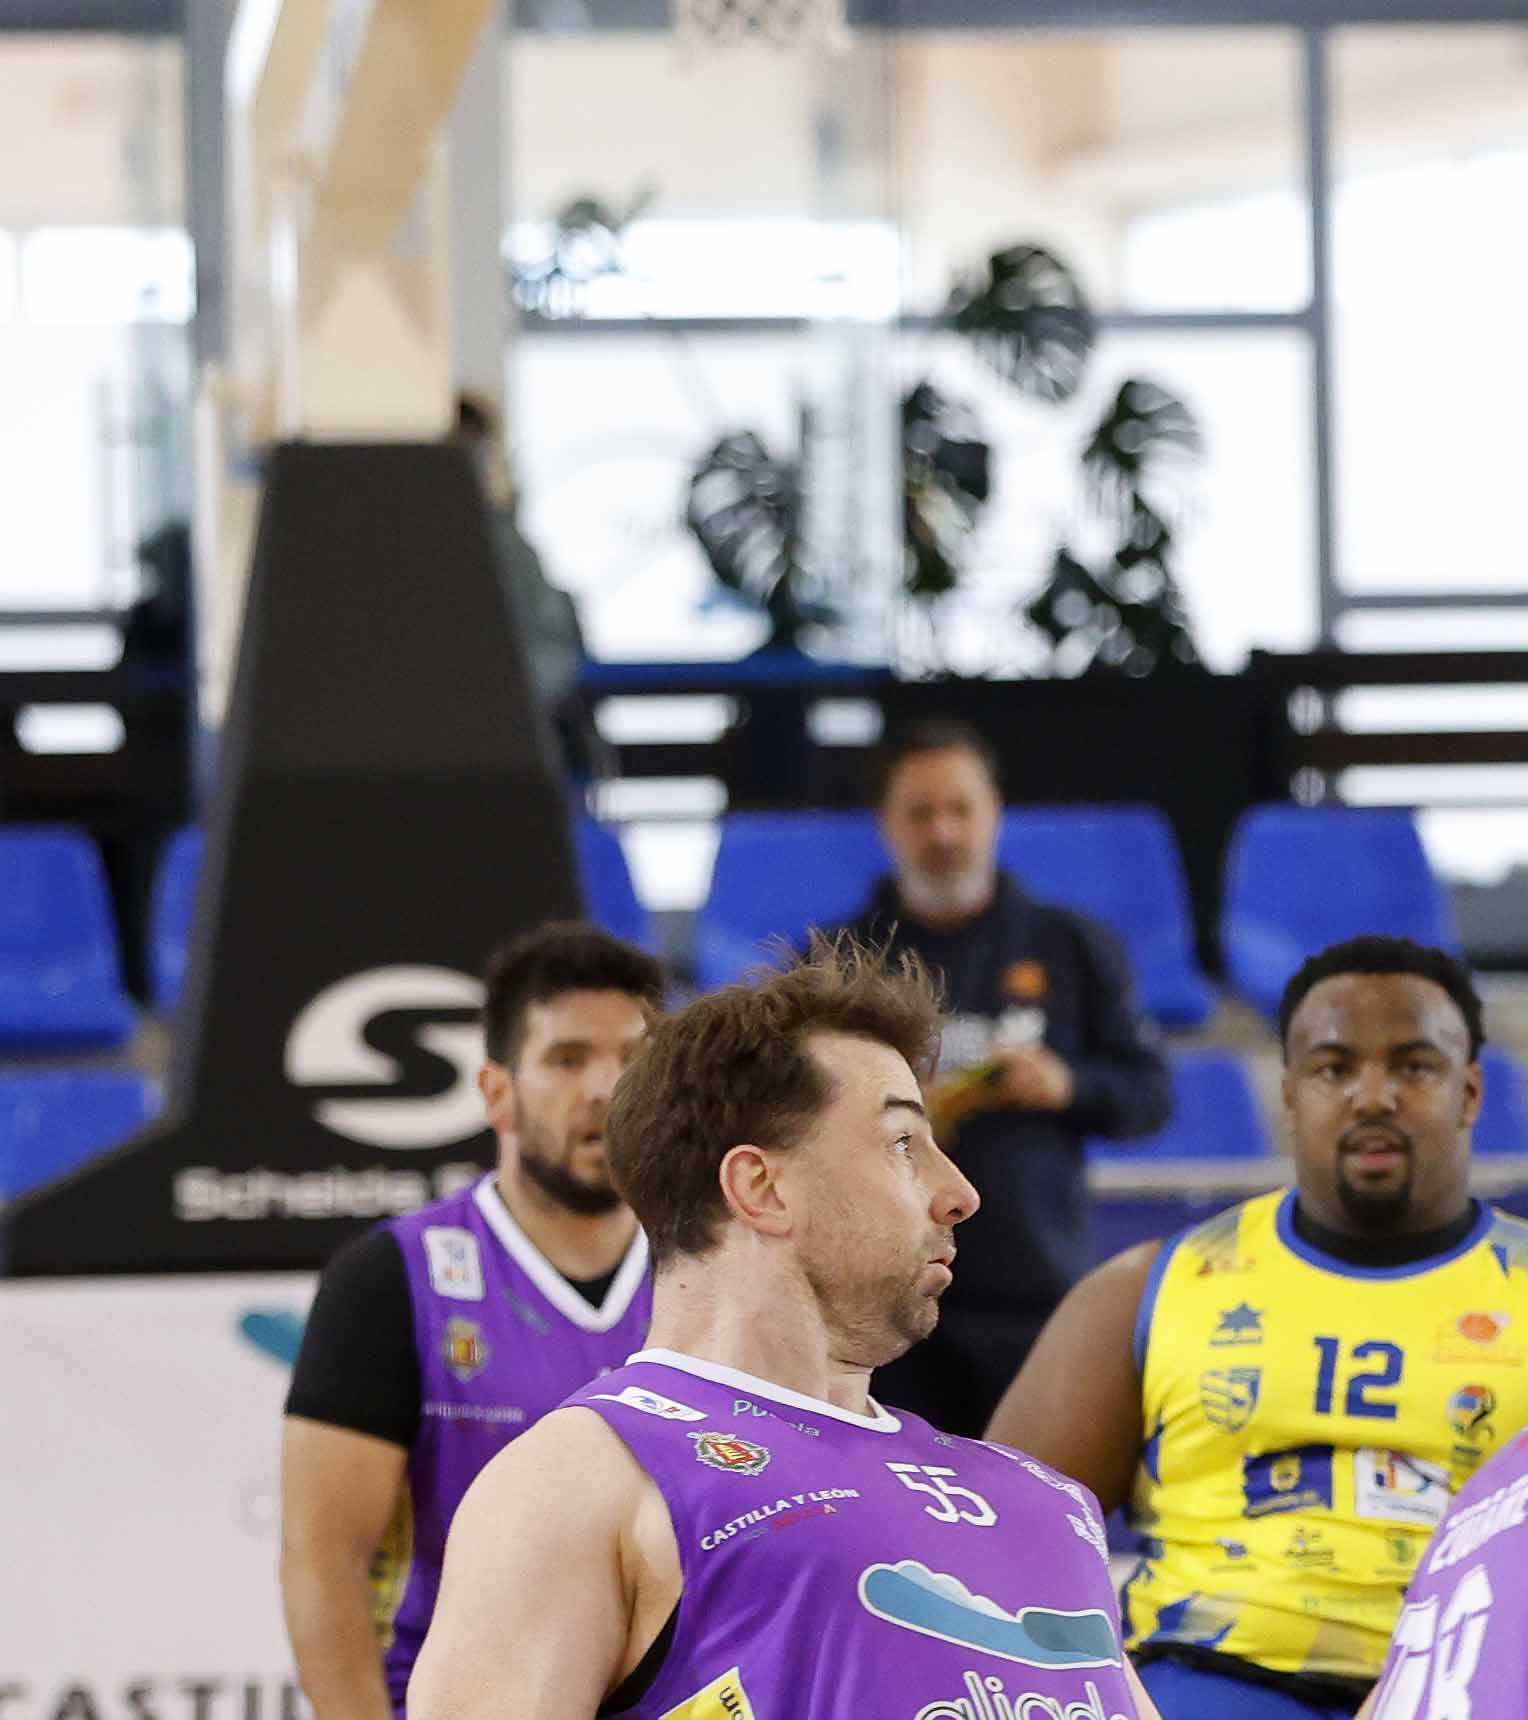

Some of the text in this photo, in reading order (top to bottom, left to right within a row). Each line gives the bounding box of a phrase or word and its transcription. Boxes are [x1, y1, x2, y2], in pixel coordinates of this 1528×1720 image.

[1312, 1336, 1405, 1420] 12
[700, 1497, 792, 1551] CASTILLA
[791, 1494, 806, 1506] Y
[808, 1486, 862, 1502] LEÓN
[884, 1462, 998, 1527] 55
